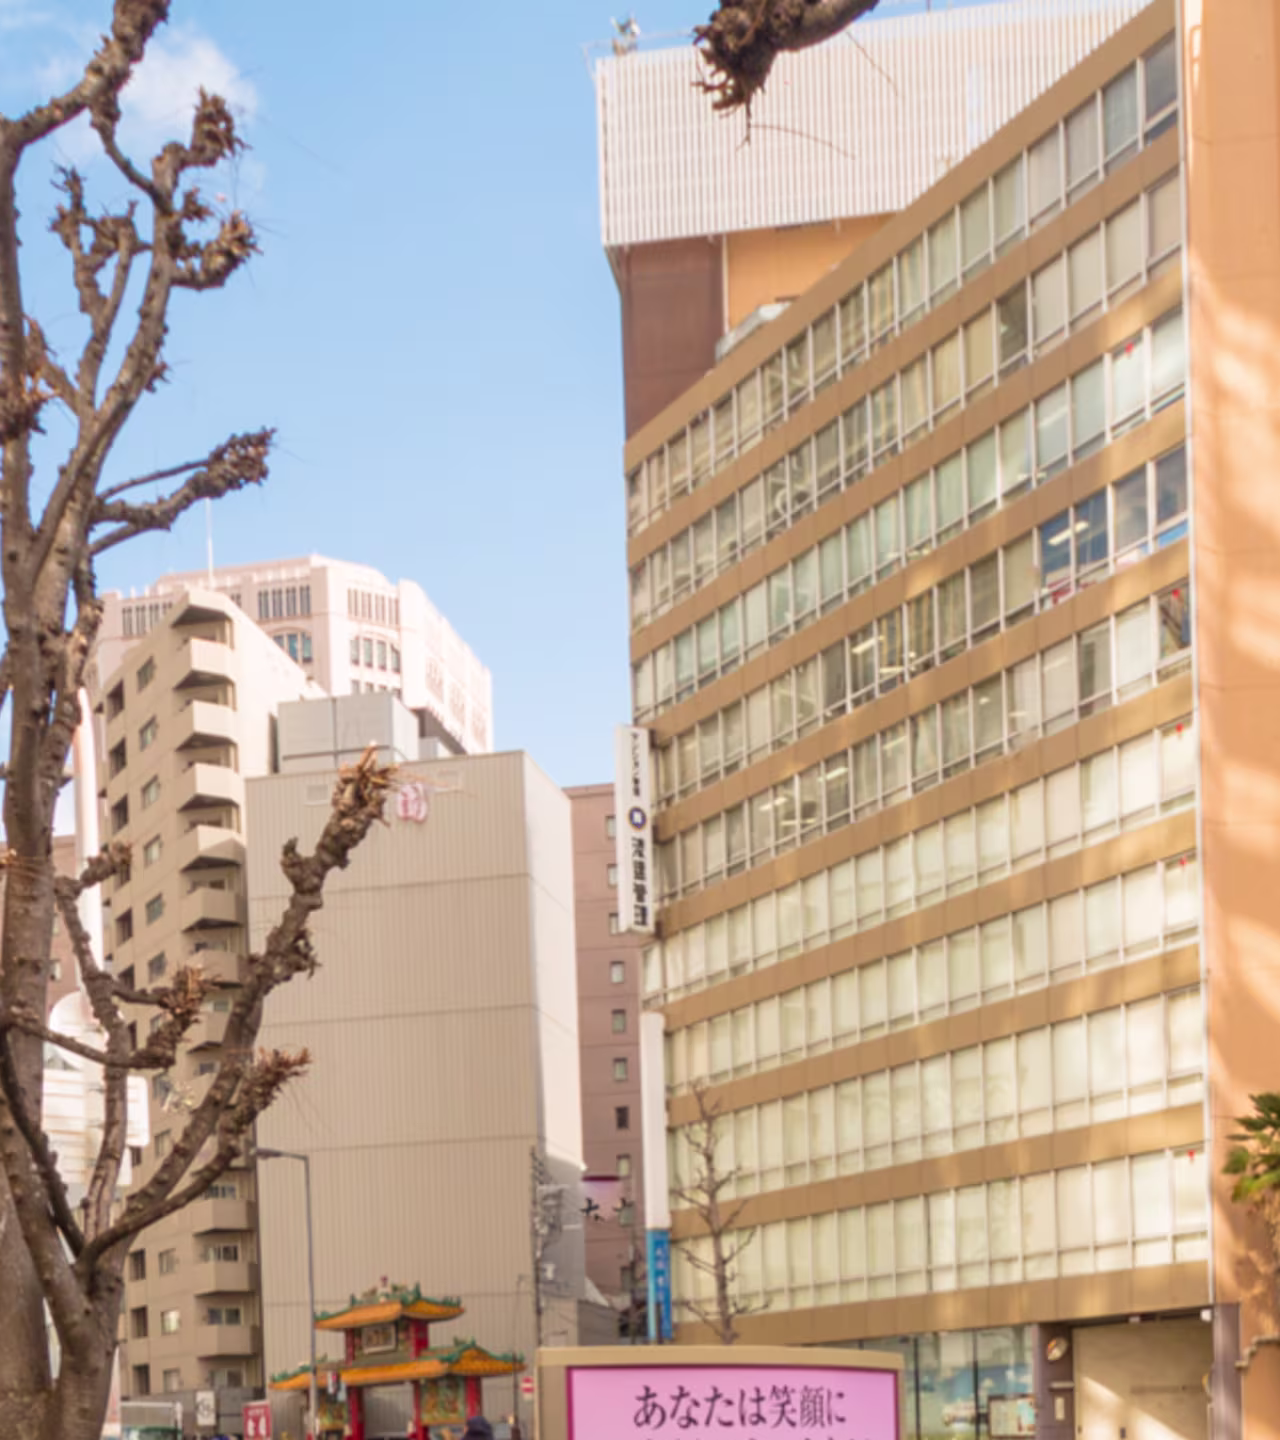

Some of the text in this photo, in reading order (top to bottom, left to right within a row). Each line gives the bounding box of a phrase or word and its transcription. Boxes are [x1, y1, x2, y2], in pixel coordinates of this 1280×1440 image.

[633, 1384, 847, 1430] あなたは笑顔に
